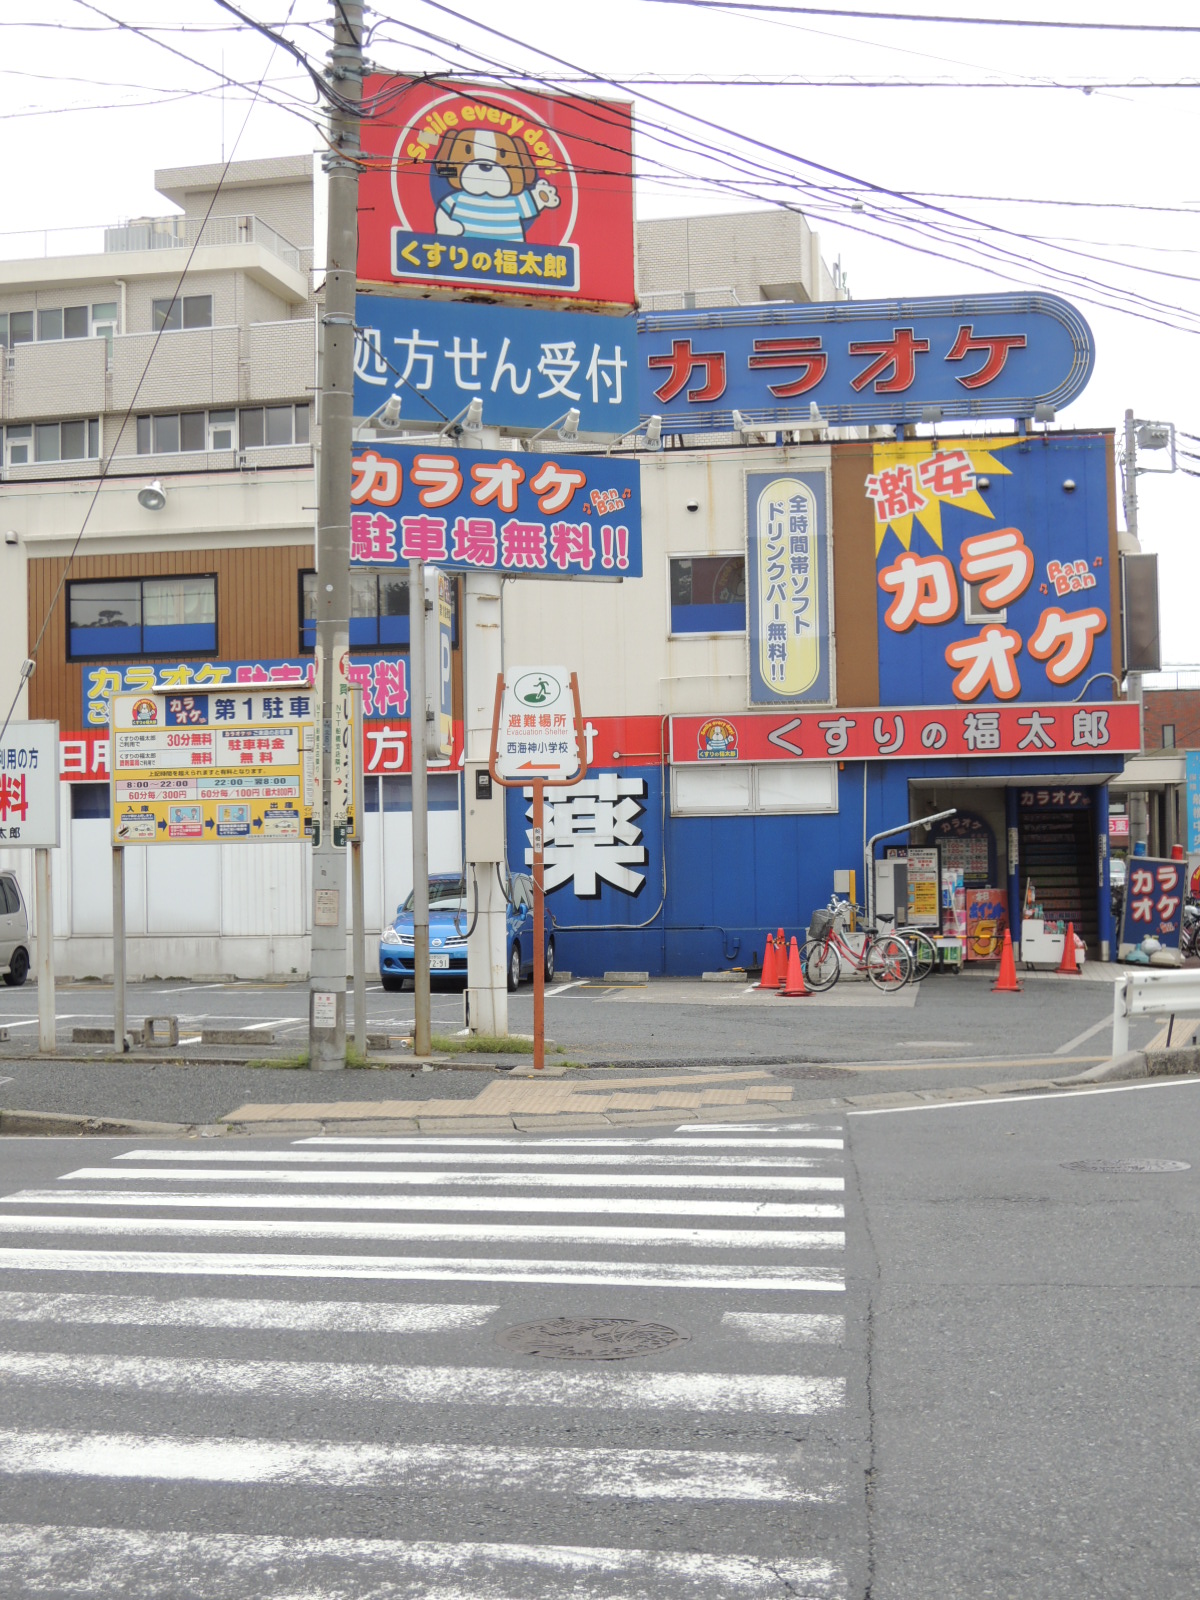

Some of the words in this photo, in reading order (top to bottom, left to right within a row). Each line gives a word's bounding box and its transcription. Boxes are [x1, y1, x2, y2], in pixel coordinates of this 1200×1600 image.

[461, 105, 524, 135] every
[401, 240, 567, 278] くすりの福太郎
[647, 324, 1027, 404] カラオケ
[351, 451, 586, 514] カラオケ
[866, 449, 976, 522] 激安
[590, 488, 619, 506] Ban
[597, 498, 625, 516] Ban
[788, 494, 811, 635] 全時間帯ソフト
[1047, 559, 1088, 582] Ban
[1053, 573, 1096, 596] Ban
[508, 713, 567, 728] 避難場所
[167, 733, 212, 747] 30分無料
[507, 728, 542, 736] Evacuation
[545, 728, 568, 736] Shelter
[767, 710, 1110, 756] くすりの福太郎
[228, 738, 285, 751] 駐車料金
[507, 742, 568, 754] 西海神小学校
[191, 752, 212, 764] 無料
[1021, 791, 1082, 805] カラオケ
